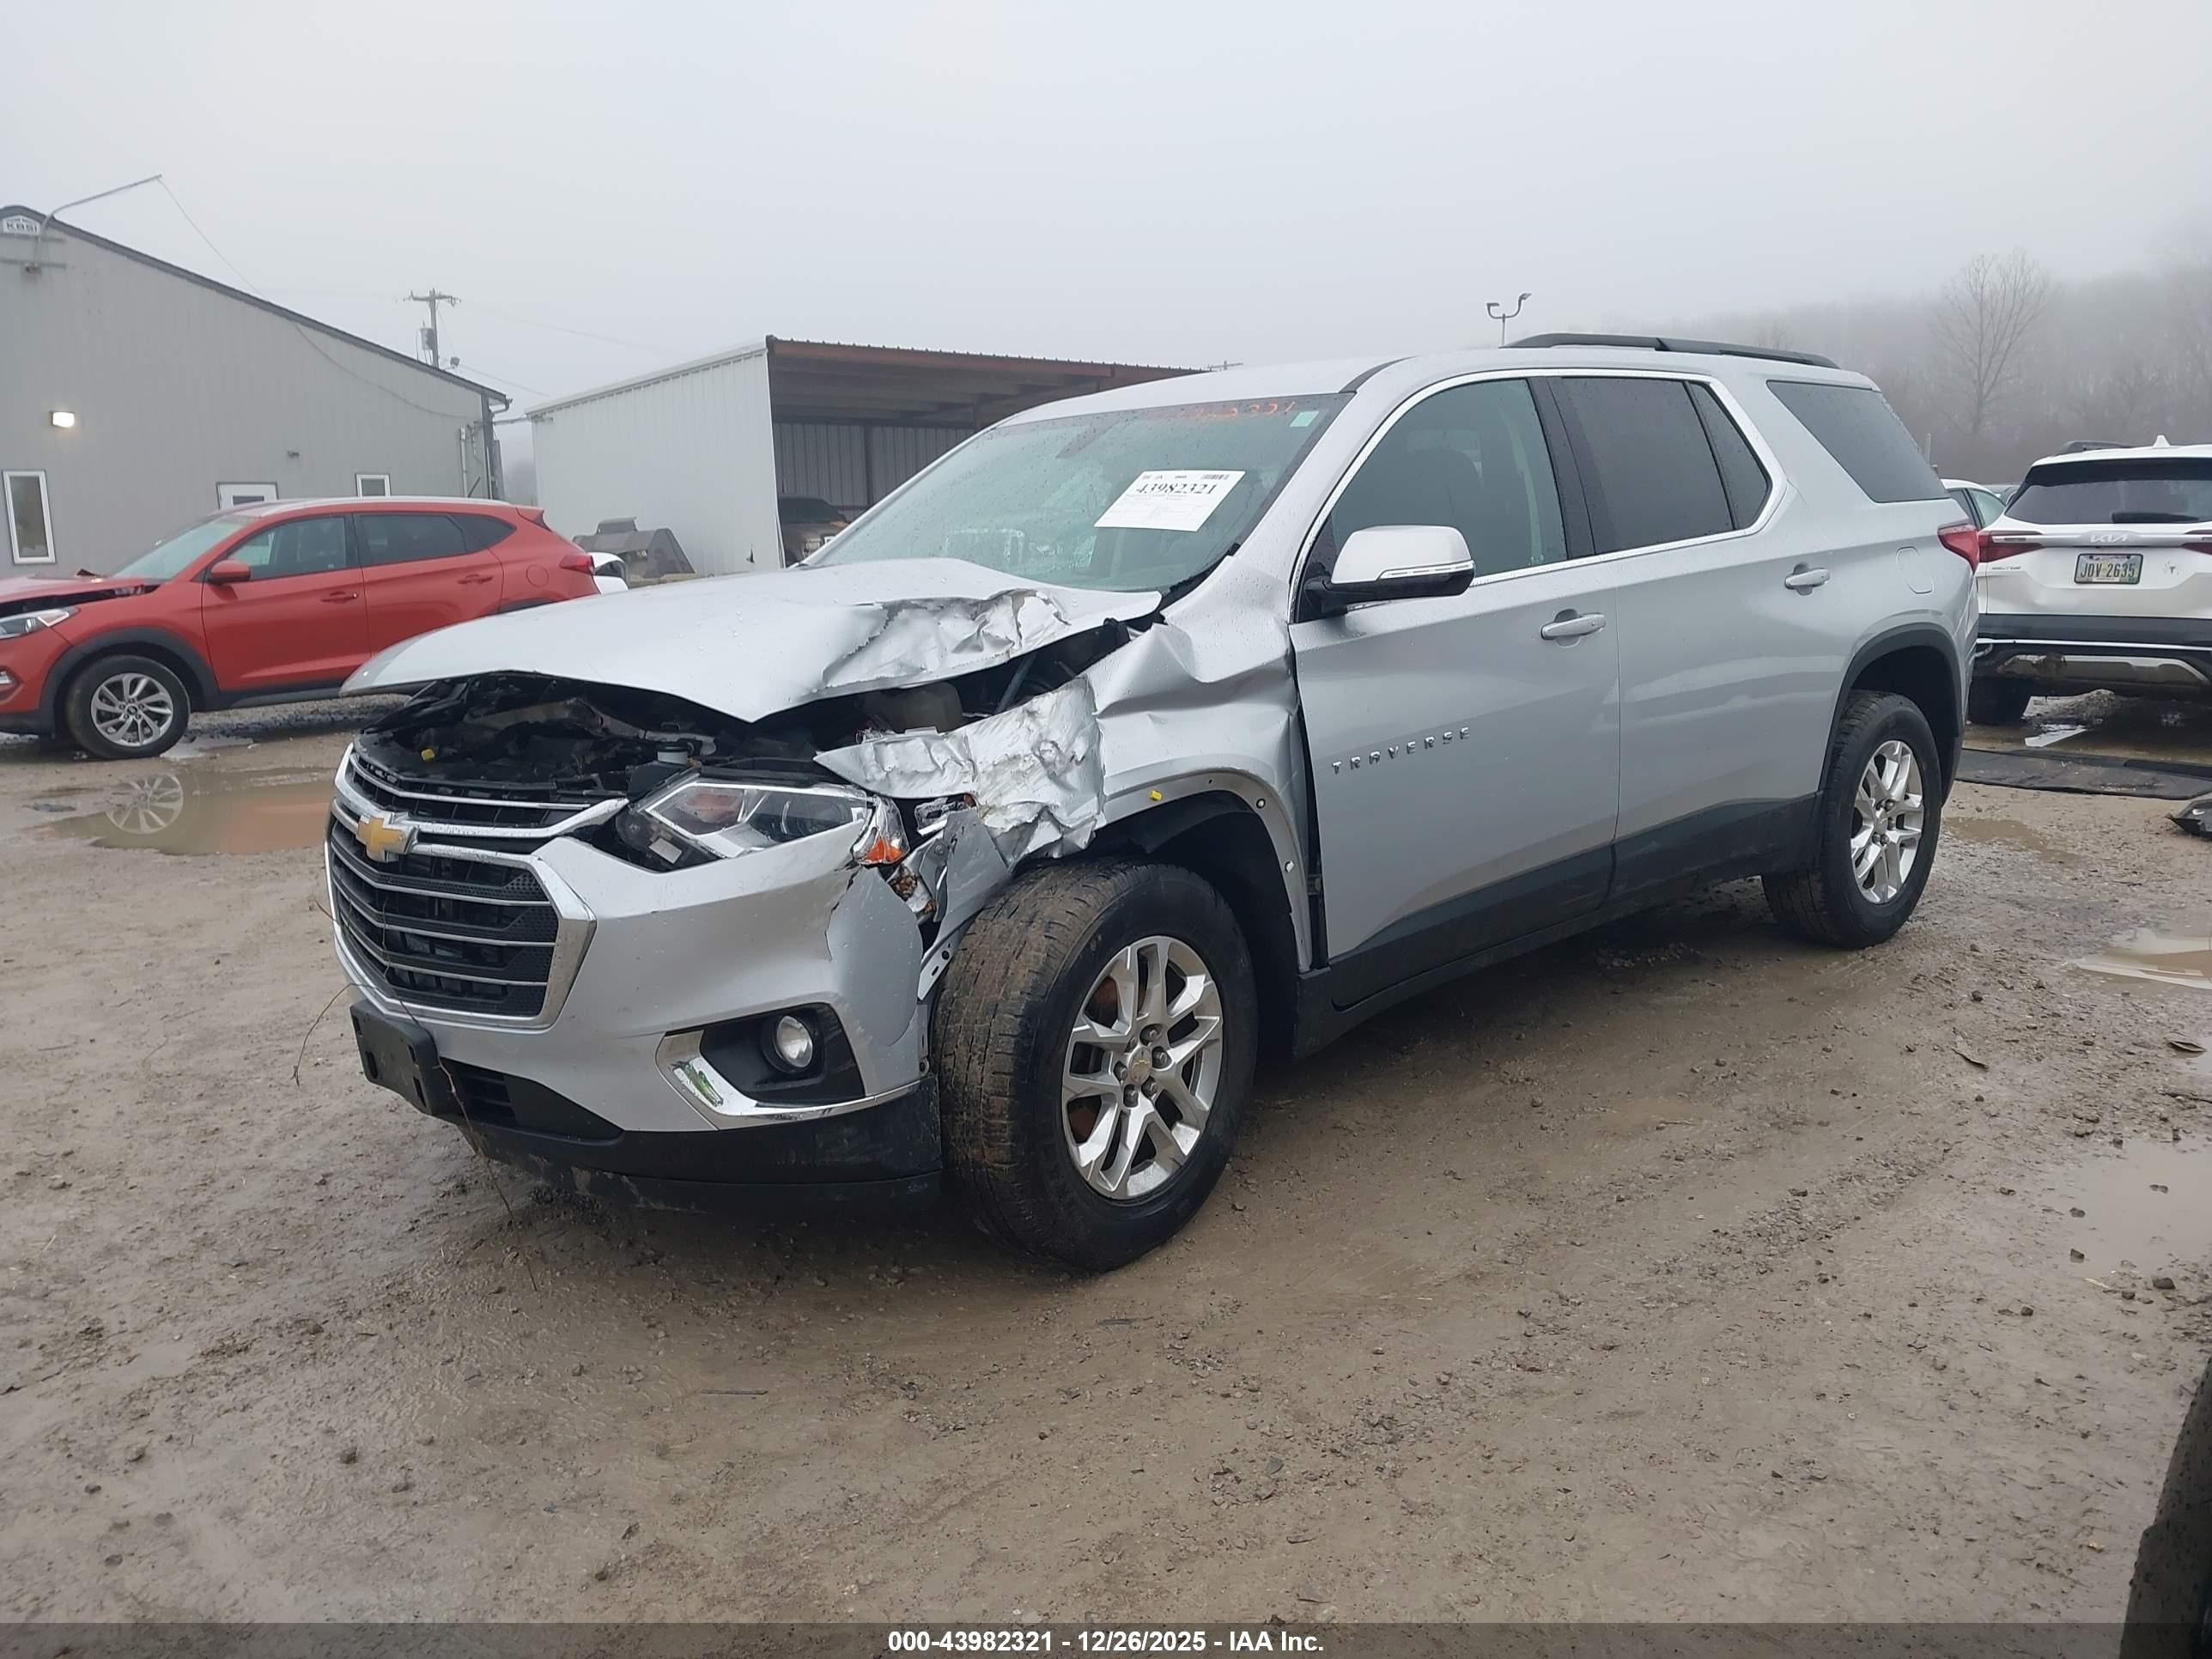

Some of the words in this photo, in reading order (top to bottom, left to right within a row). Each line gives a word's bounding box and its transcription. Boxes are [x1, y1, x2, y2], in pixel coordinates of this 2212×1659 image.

[1136, 482, 1218, 495] 43982321
[2106, 562, 2136, 578] 2635
[1331, 726, 1470, 775] TRAVERSE
